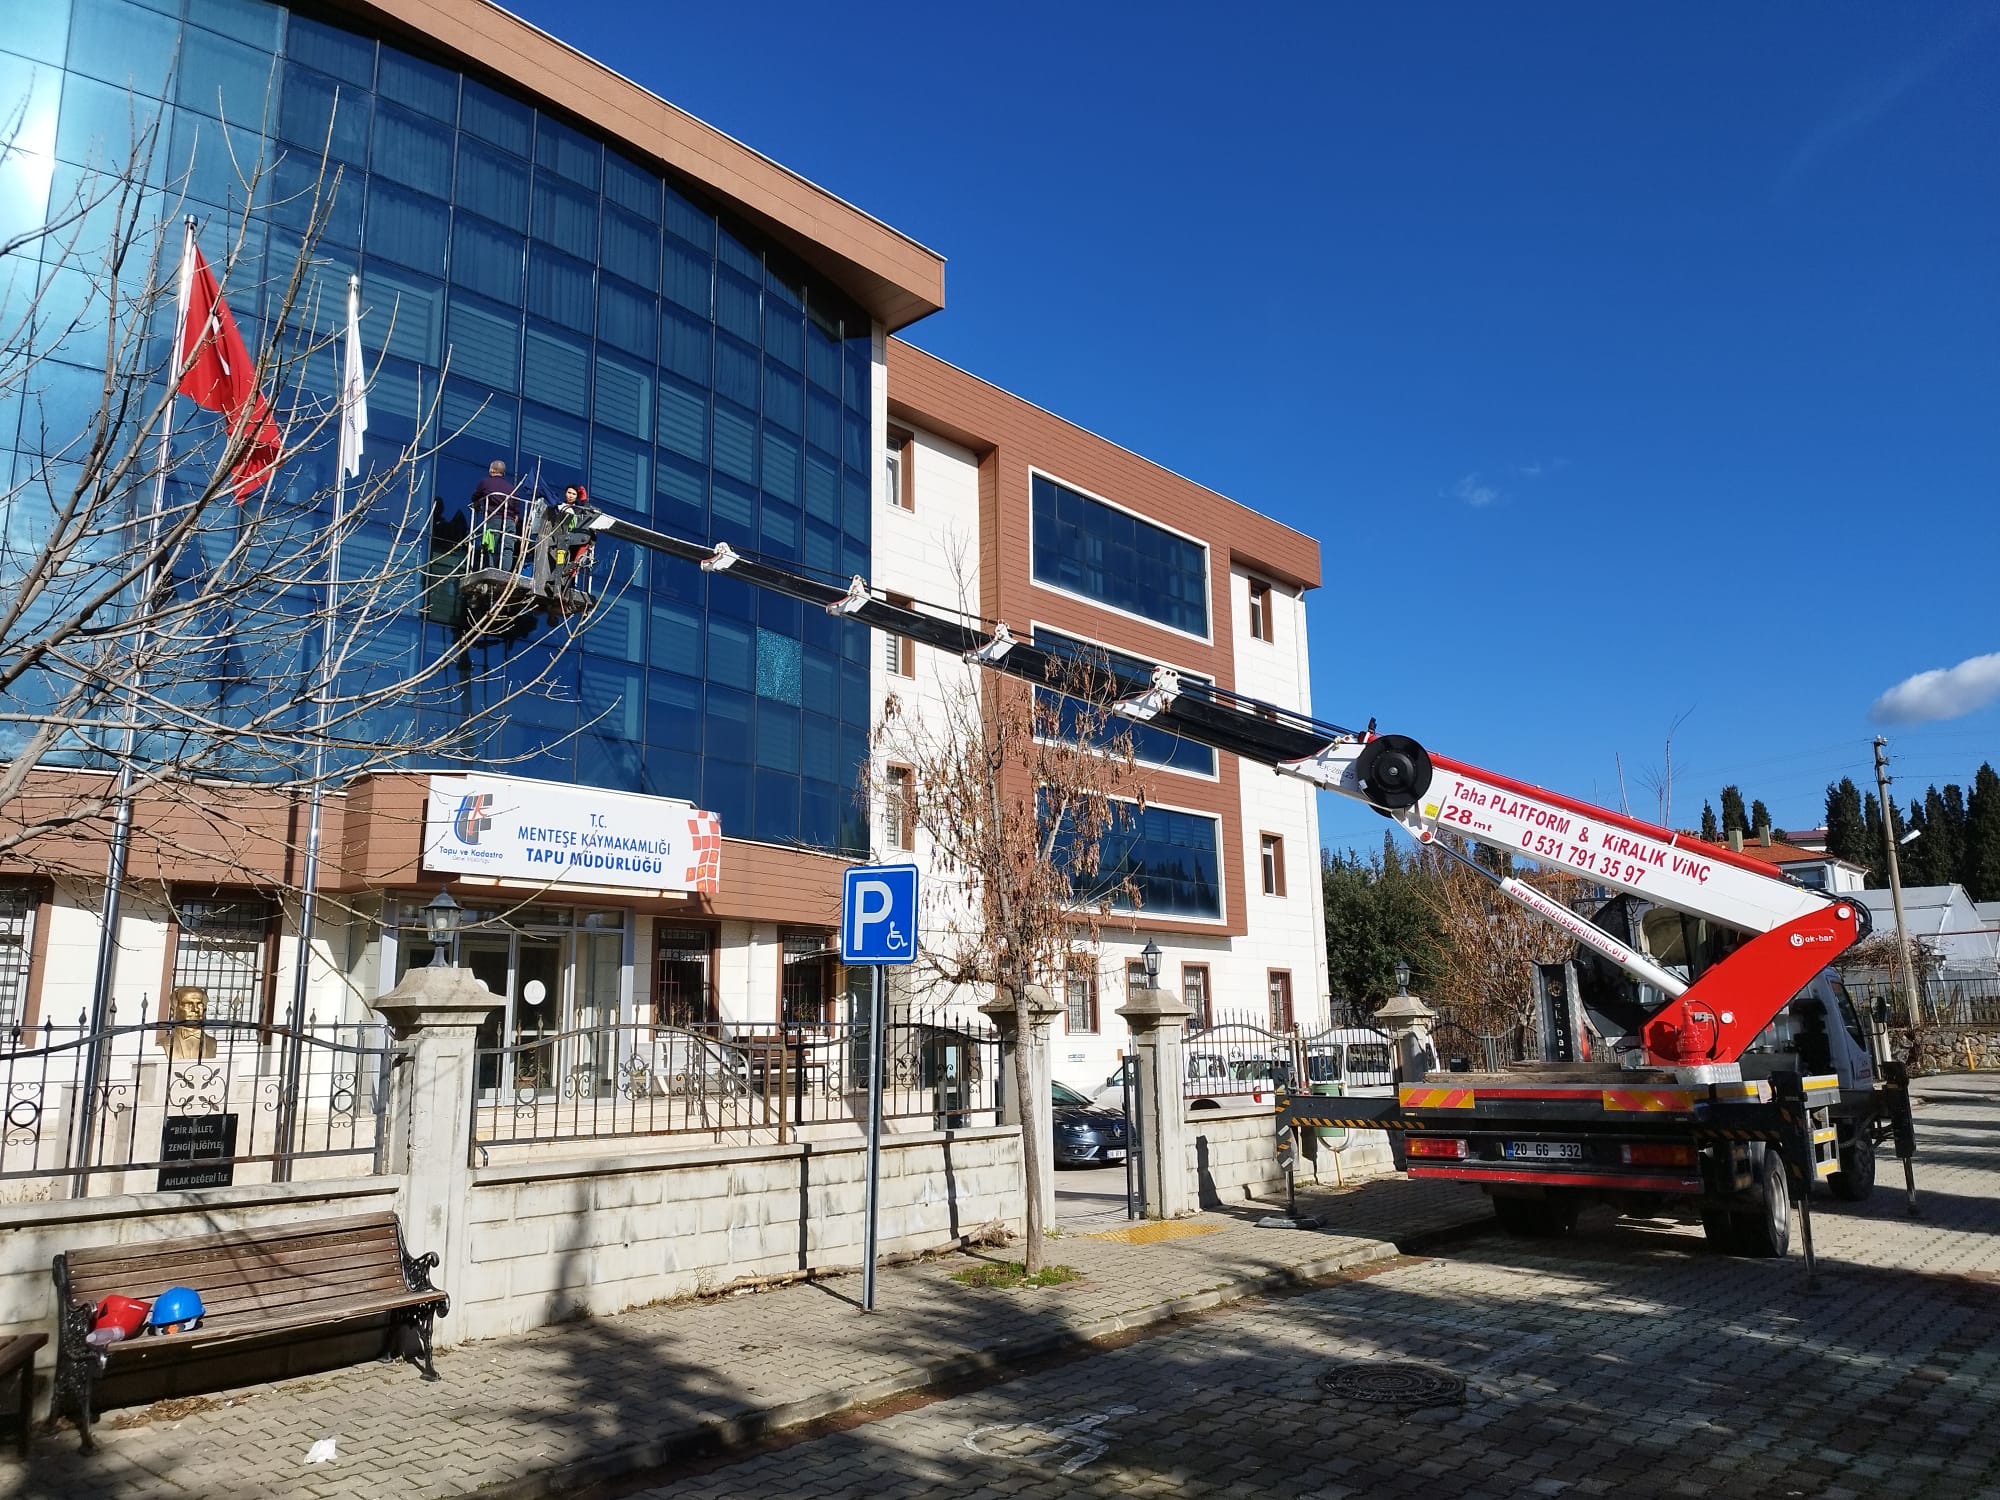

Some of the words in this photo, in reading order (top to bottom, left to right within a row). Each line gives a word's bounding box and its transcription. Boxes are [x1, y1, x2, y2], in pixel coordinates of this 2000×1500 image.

[590, 813, 607, 828] T.C.
[1443, 805, 1473, 825] 28
[1473, 821, 1493, 832] mt
[1454, 781, 1487, 806] Taha
[1490, 795, 1571, 834] PLATFORM
[1578, 826, 1589, 843] &
[439, 846, 458, 856] Tapu
[470, 849, 504, 859] Kadastro
[518, 825, 577, 848] MENTEŞE
[581, 832, 671, 855] KAYMAKAMLIĞI
[526, 847, 565, 865] TAPU
[569, 850, 662, 874] MÜDÜRLÜĞÜ
[1521, 830, 1533, 847] 0
[1535, 836, 1563, 859] 531
[1568, 846, 1596, 870] 791
[1599, 857, 1622, 878] 35
[1623, 865, 1646, 885] 97
[853, 880, 893, 951] P
[1514, 1143, 1528, 1156] 20
[1535, 1144, 1549, 1156] GG
[1559, 1145, 1581, 1157] 332
[165, 1176, 189, 1186] AHLAK
